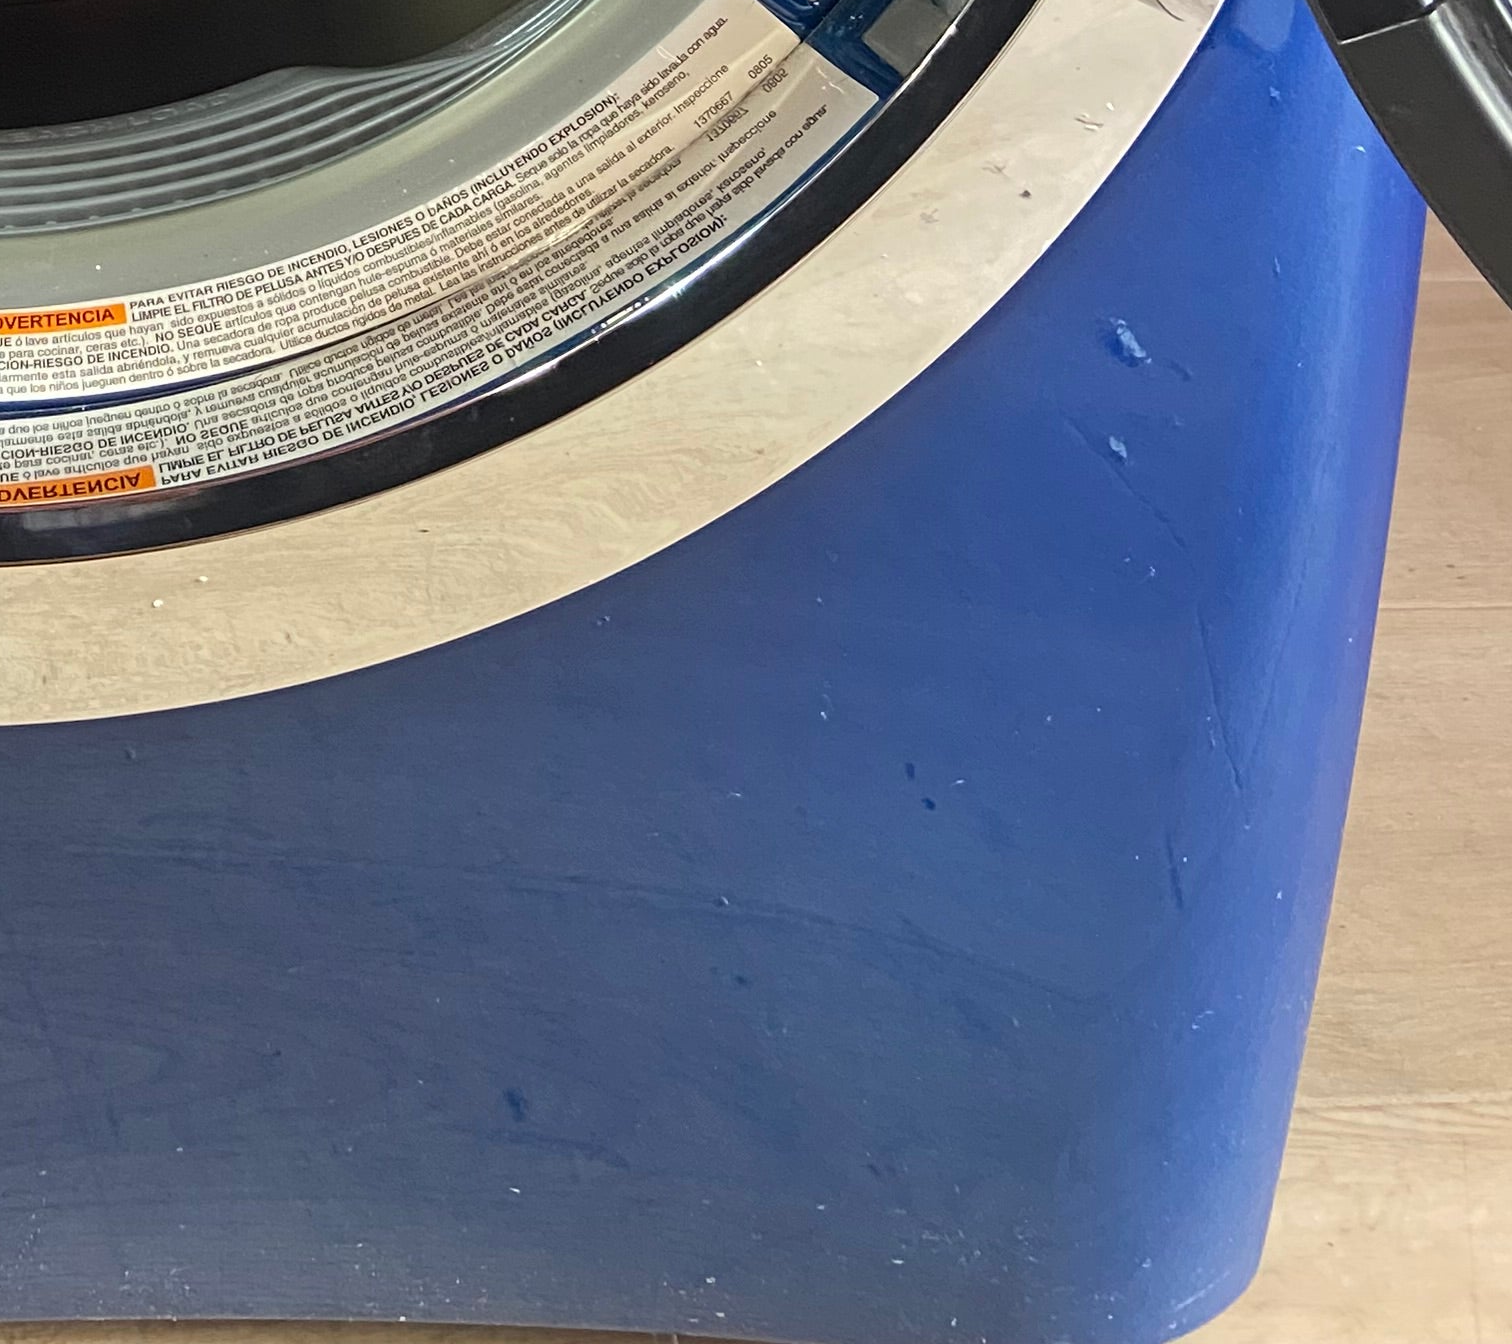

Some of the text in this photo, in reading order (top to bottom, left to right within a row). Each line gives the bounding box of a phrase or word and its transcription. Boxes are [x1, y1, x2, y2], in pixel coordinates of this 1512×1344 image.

[693, 55, 774, 129] 1370667 0805
[130, 92, 622, 309] PARA EVITAR RIESGO DE INCENDIO, LESIONES O DAÑOS (INCLUYENDO EXPLOSION):
[132, 308, 173, 322] LIMPIE
[175, 303, 189, 314] EL
[192, 293, 234, 311] FILTRO
[236, 290, 253, 301] DE
[256, 275, 303, 295] PELUSA
[305, 260, 344, 280] ANTES
[347, 253, 365, 266] Y/O
[367, 228, 421, 259] DESPUES
[423, 220, 438, 233] DE
[440, 204, 472, 225] CADA
[473, 180, 516, 207] CARGA.
[516, 161, 548, 182] Seque
[548, 146, 571, 163] solo
[568, 138, 579, 148] la
[578, 129, 601, 145] ropa
[600, 110, 619, 130] que
[619, 95, 642, 113] haya
[640, 77, 660, 96] sido
[660, 53, 688, 78] lavada
[687, 37, 705, 55] con
[87, 353, 104, 363] DE
[108, 344, 175, 360] INCENDIO.
